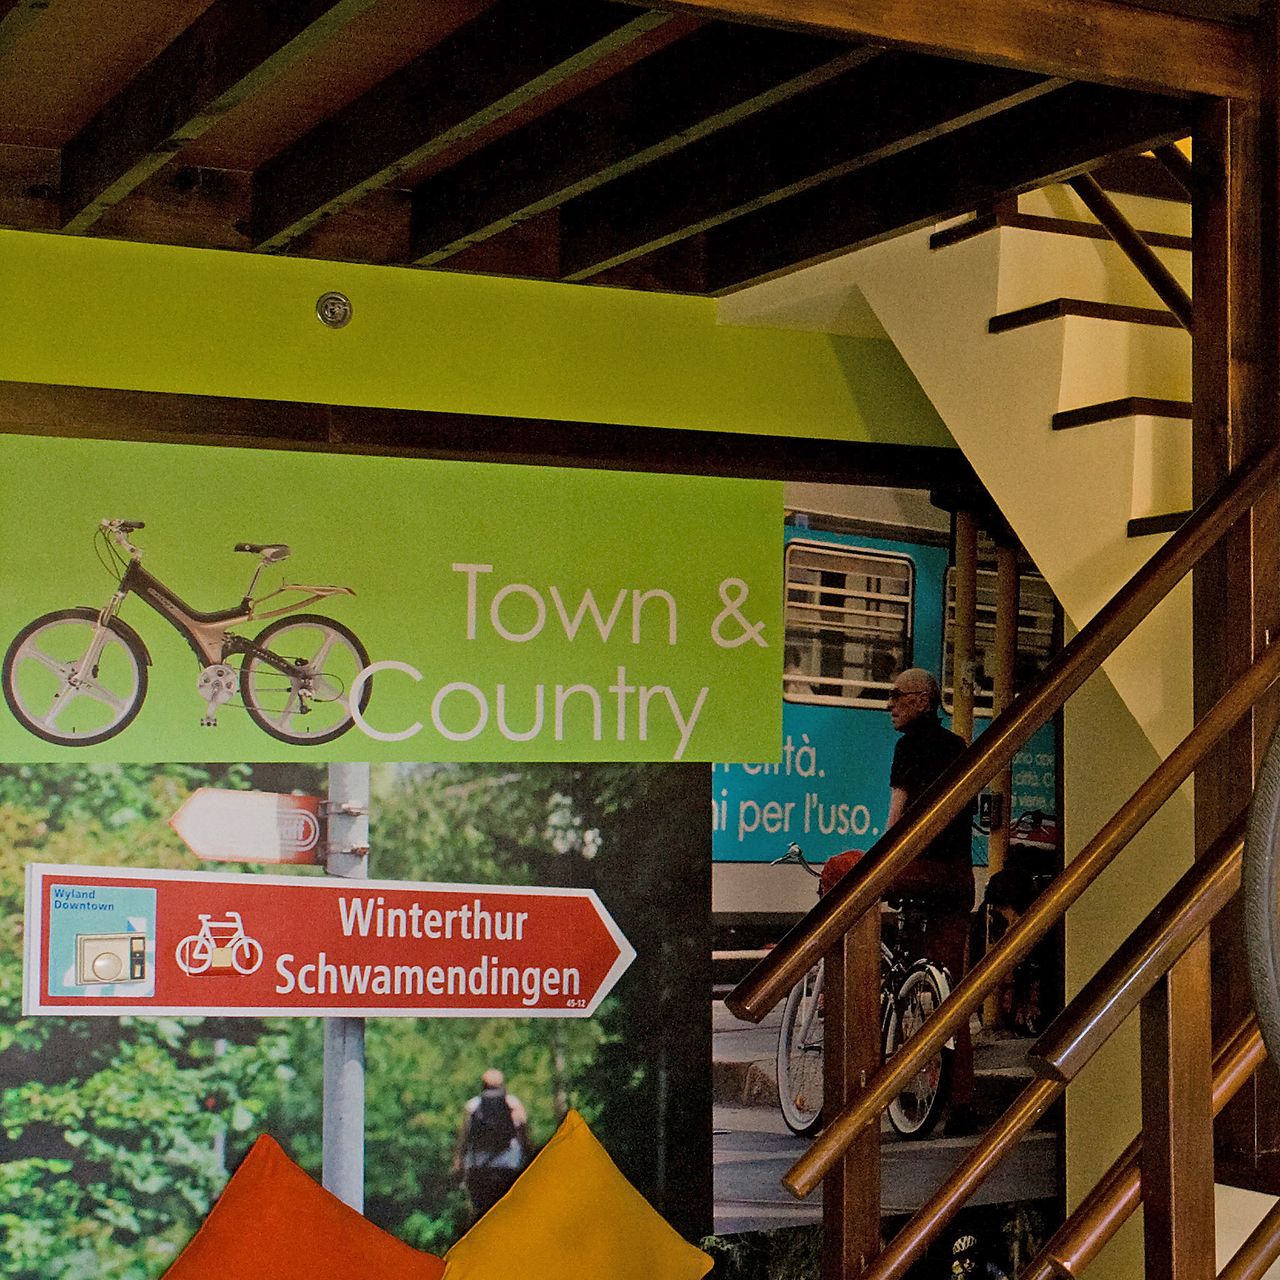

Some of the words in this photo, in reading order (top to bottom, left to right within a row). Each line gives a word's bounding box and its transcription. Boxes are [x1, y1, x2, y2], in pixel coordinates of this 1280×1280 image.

[453, 563, 677, 646] Town
[711, 577, 769, 649] &
[349, 660, 709, 761] Country
[738, 800, 795, 842] per
[804, 792, 879, 836] l'uso.
[54, 889, 96, 900] Wyland
[54, 900, 114, 911] Downtown
[338, 897, 528, 940] Winterthur
[275, 952, 580, 1006] Schwamendingen
